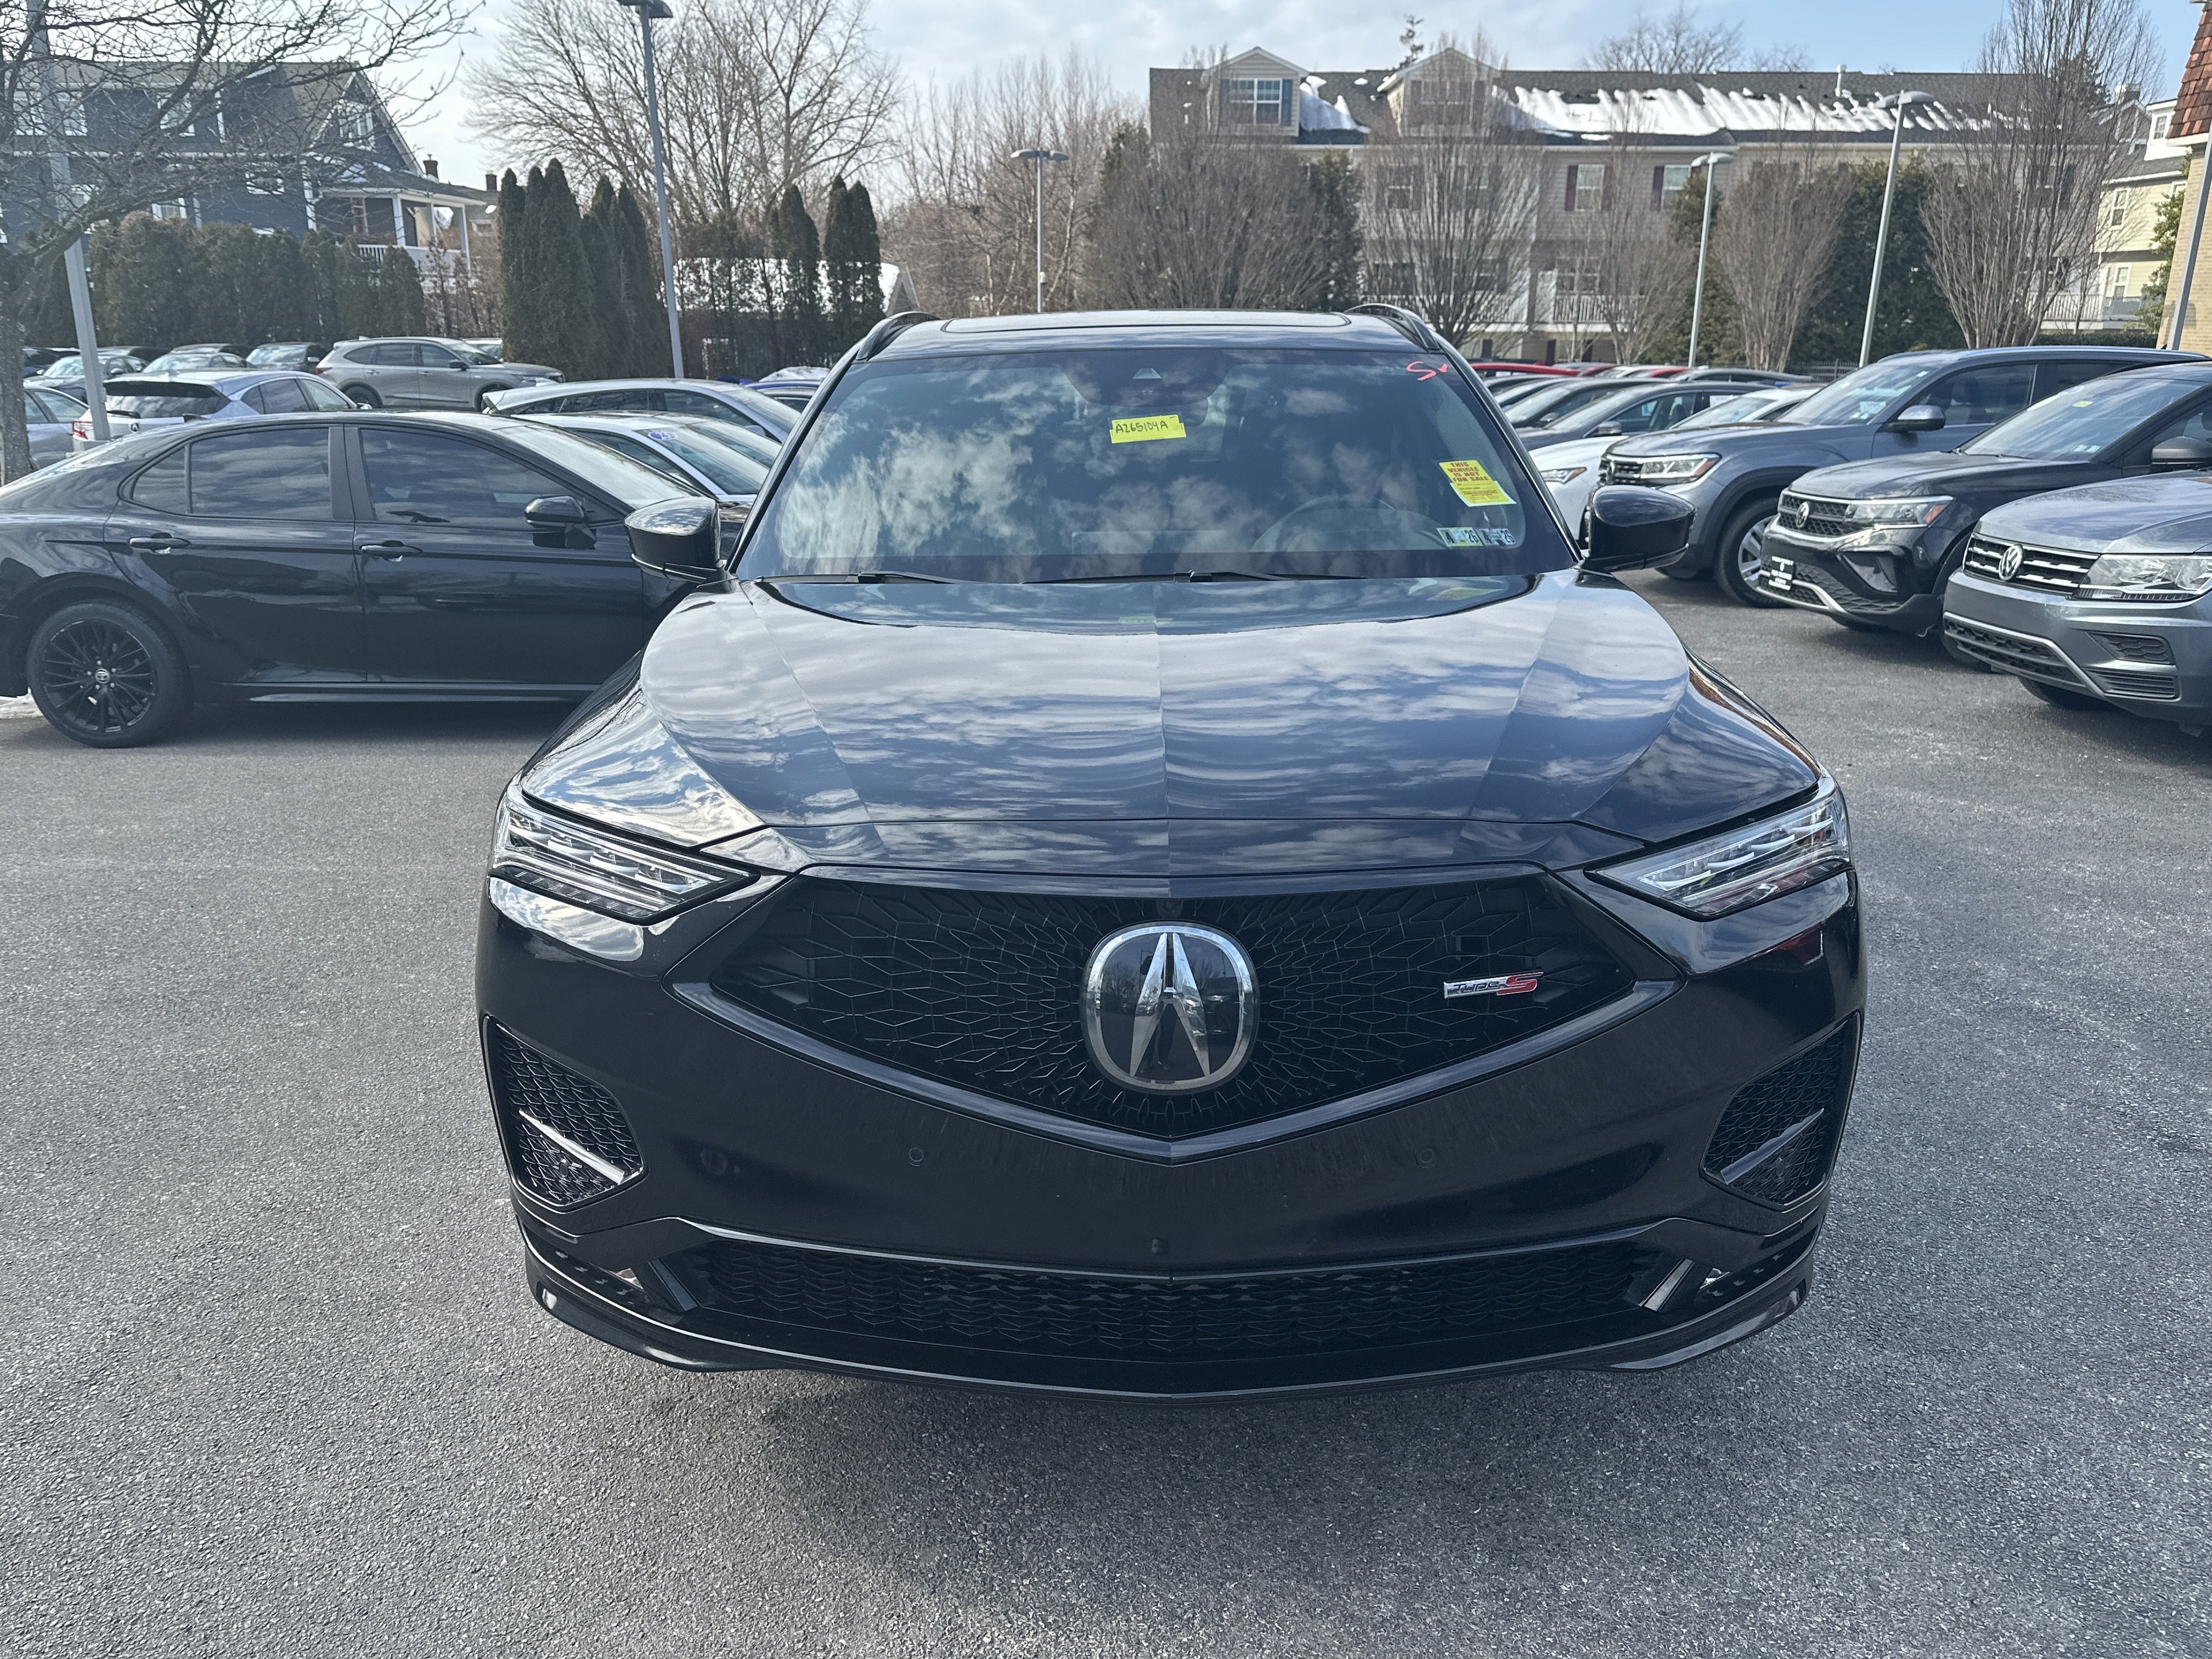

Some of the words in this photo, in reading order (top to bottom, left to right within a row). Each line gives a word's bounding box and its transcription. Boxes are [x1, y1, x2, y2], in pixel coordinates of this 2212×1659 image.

[1115, 420, 1169, 433] A265104A
[1464, 530, 1479, 543] 26
[1500, 530, 1515, 543] 26
